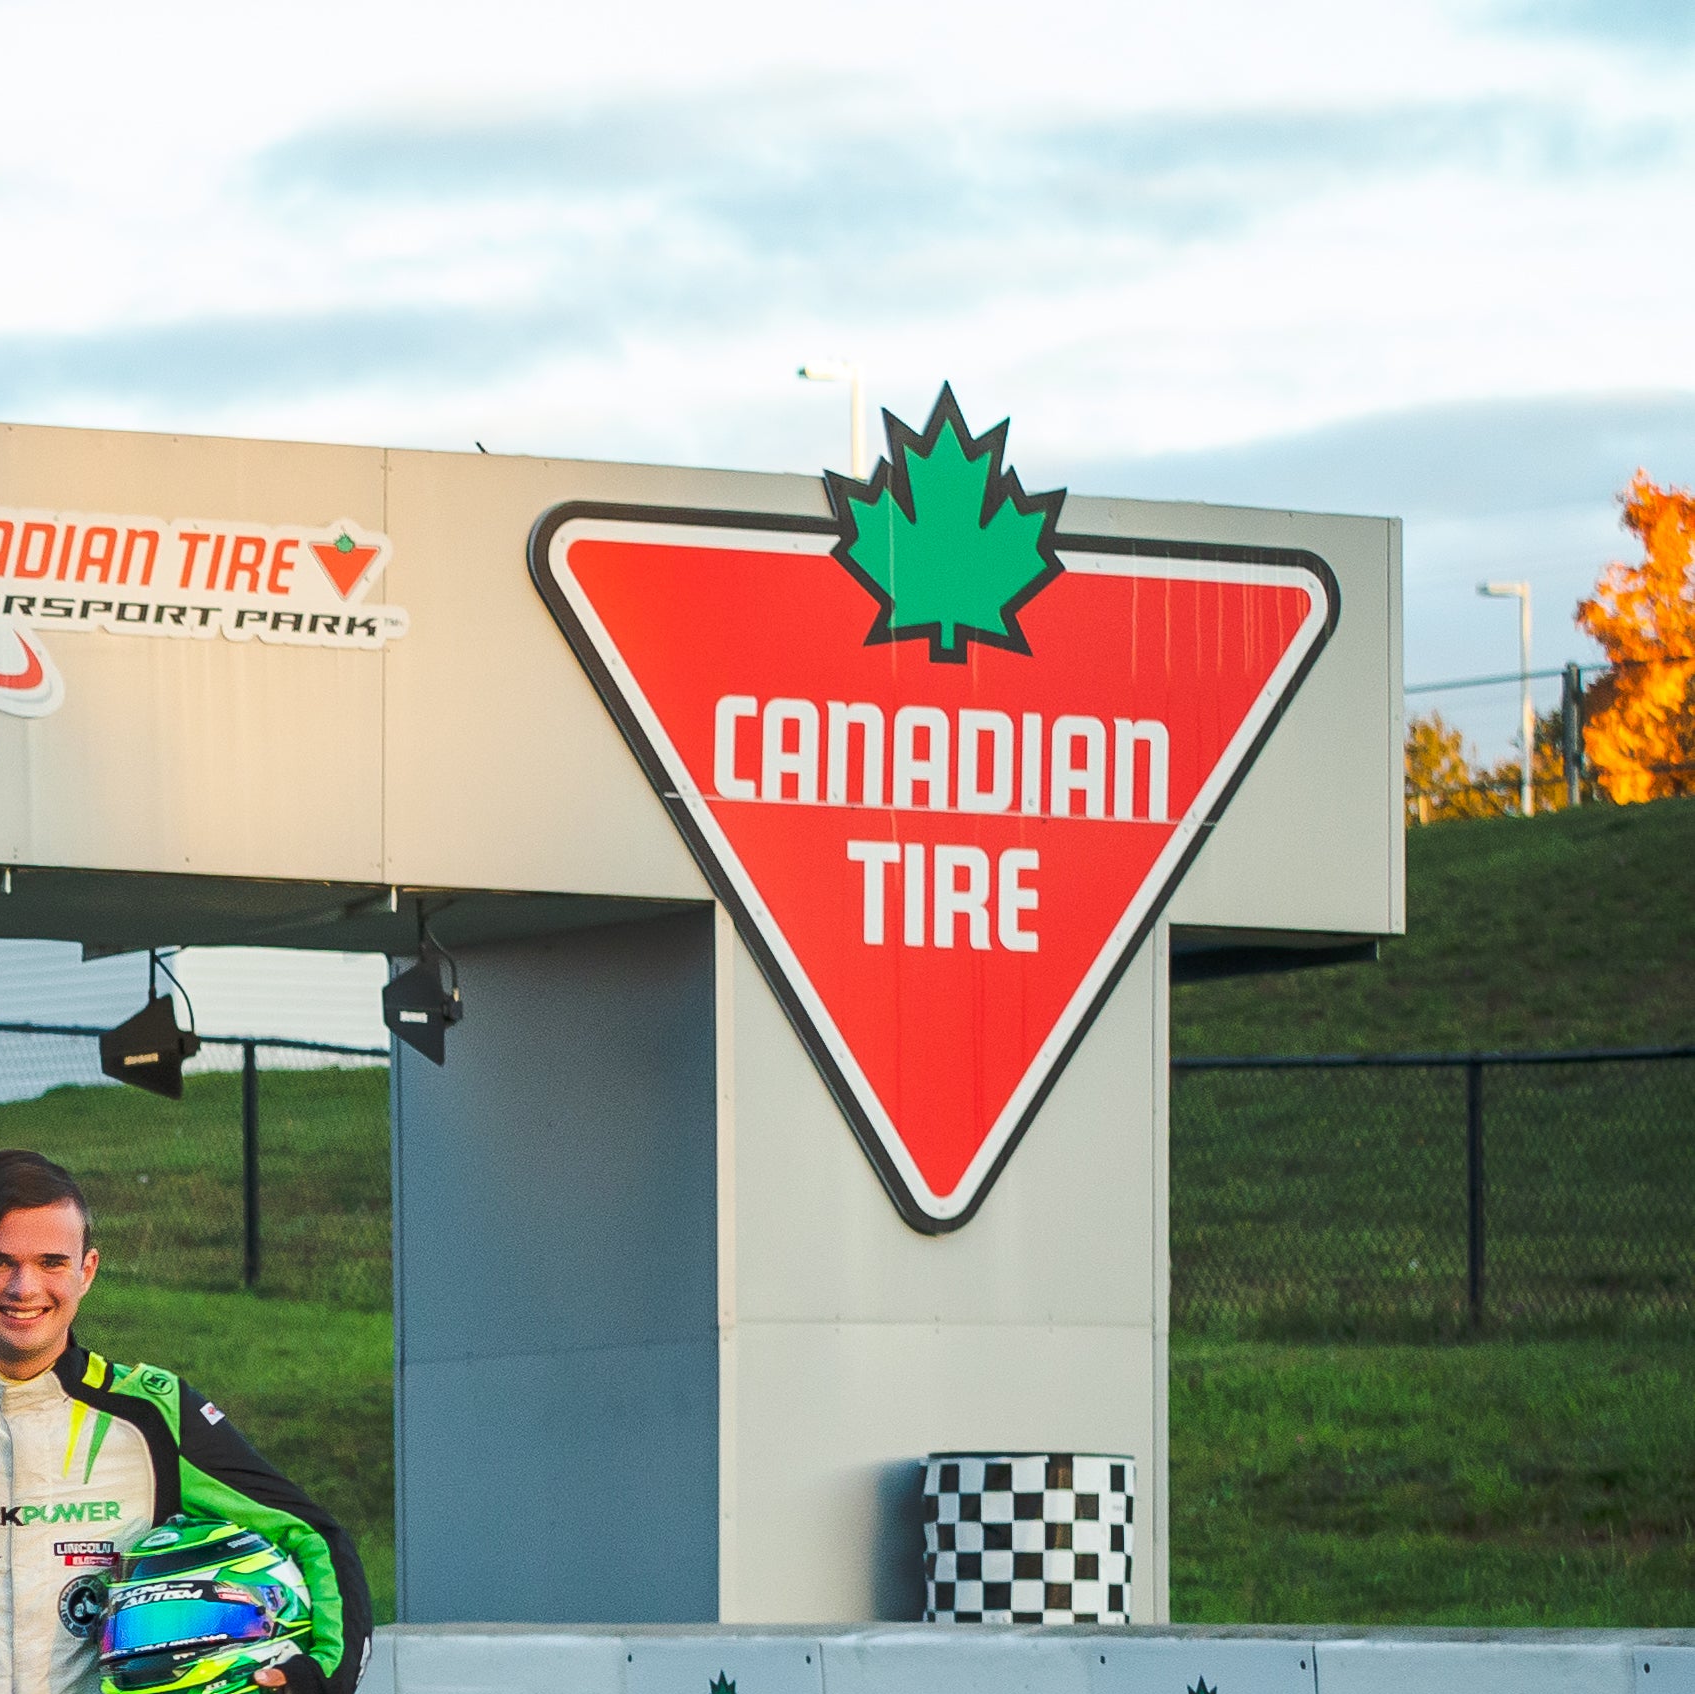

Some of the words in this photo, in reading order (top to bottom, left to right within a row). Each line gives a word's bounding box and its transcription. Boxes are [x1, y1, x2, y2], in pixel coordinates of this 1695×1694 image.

[178, 531, 300, 595] TIRE
[234, 608, 378, 637] PARK
[712, 694, 1170, 823] CANADIAN
[846, 840, 1039, 953] TIRE
[56, 1542, 112, 1554] LINCOLN
